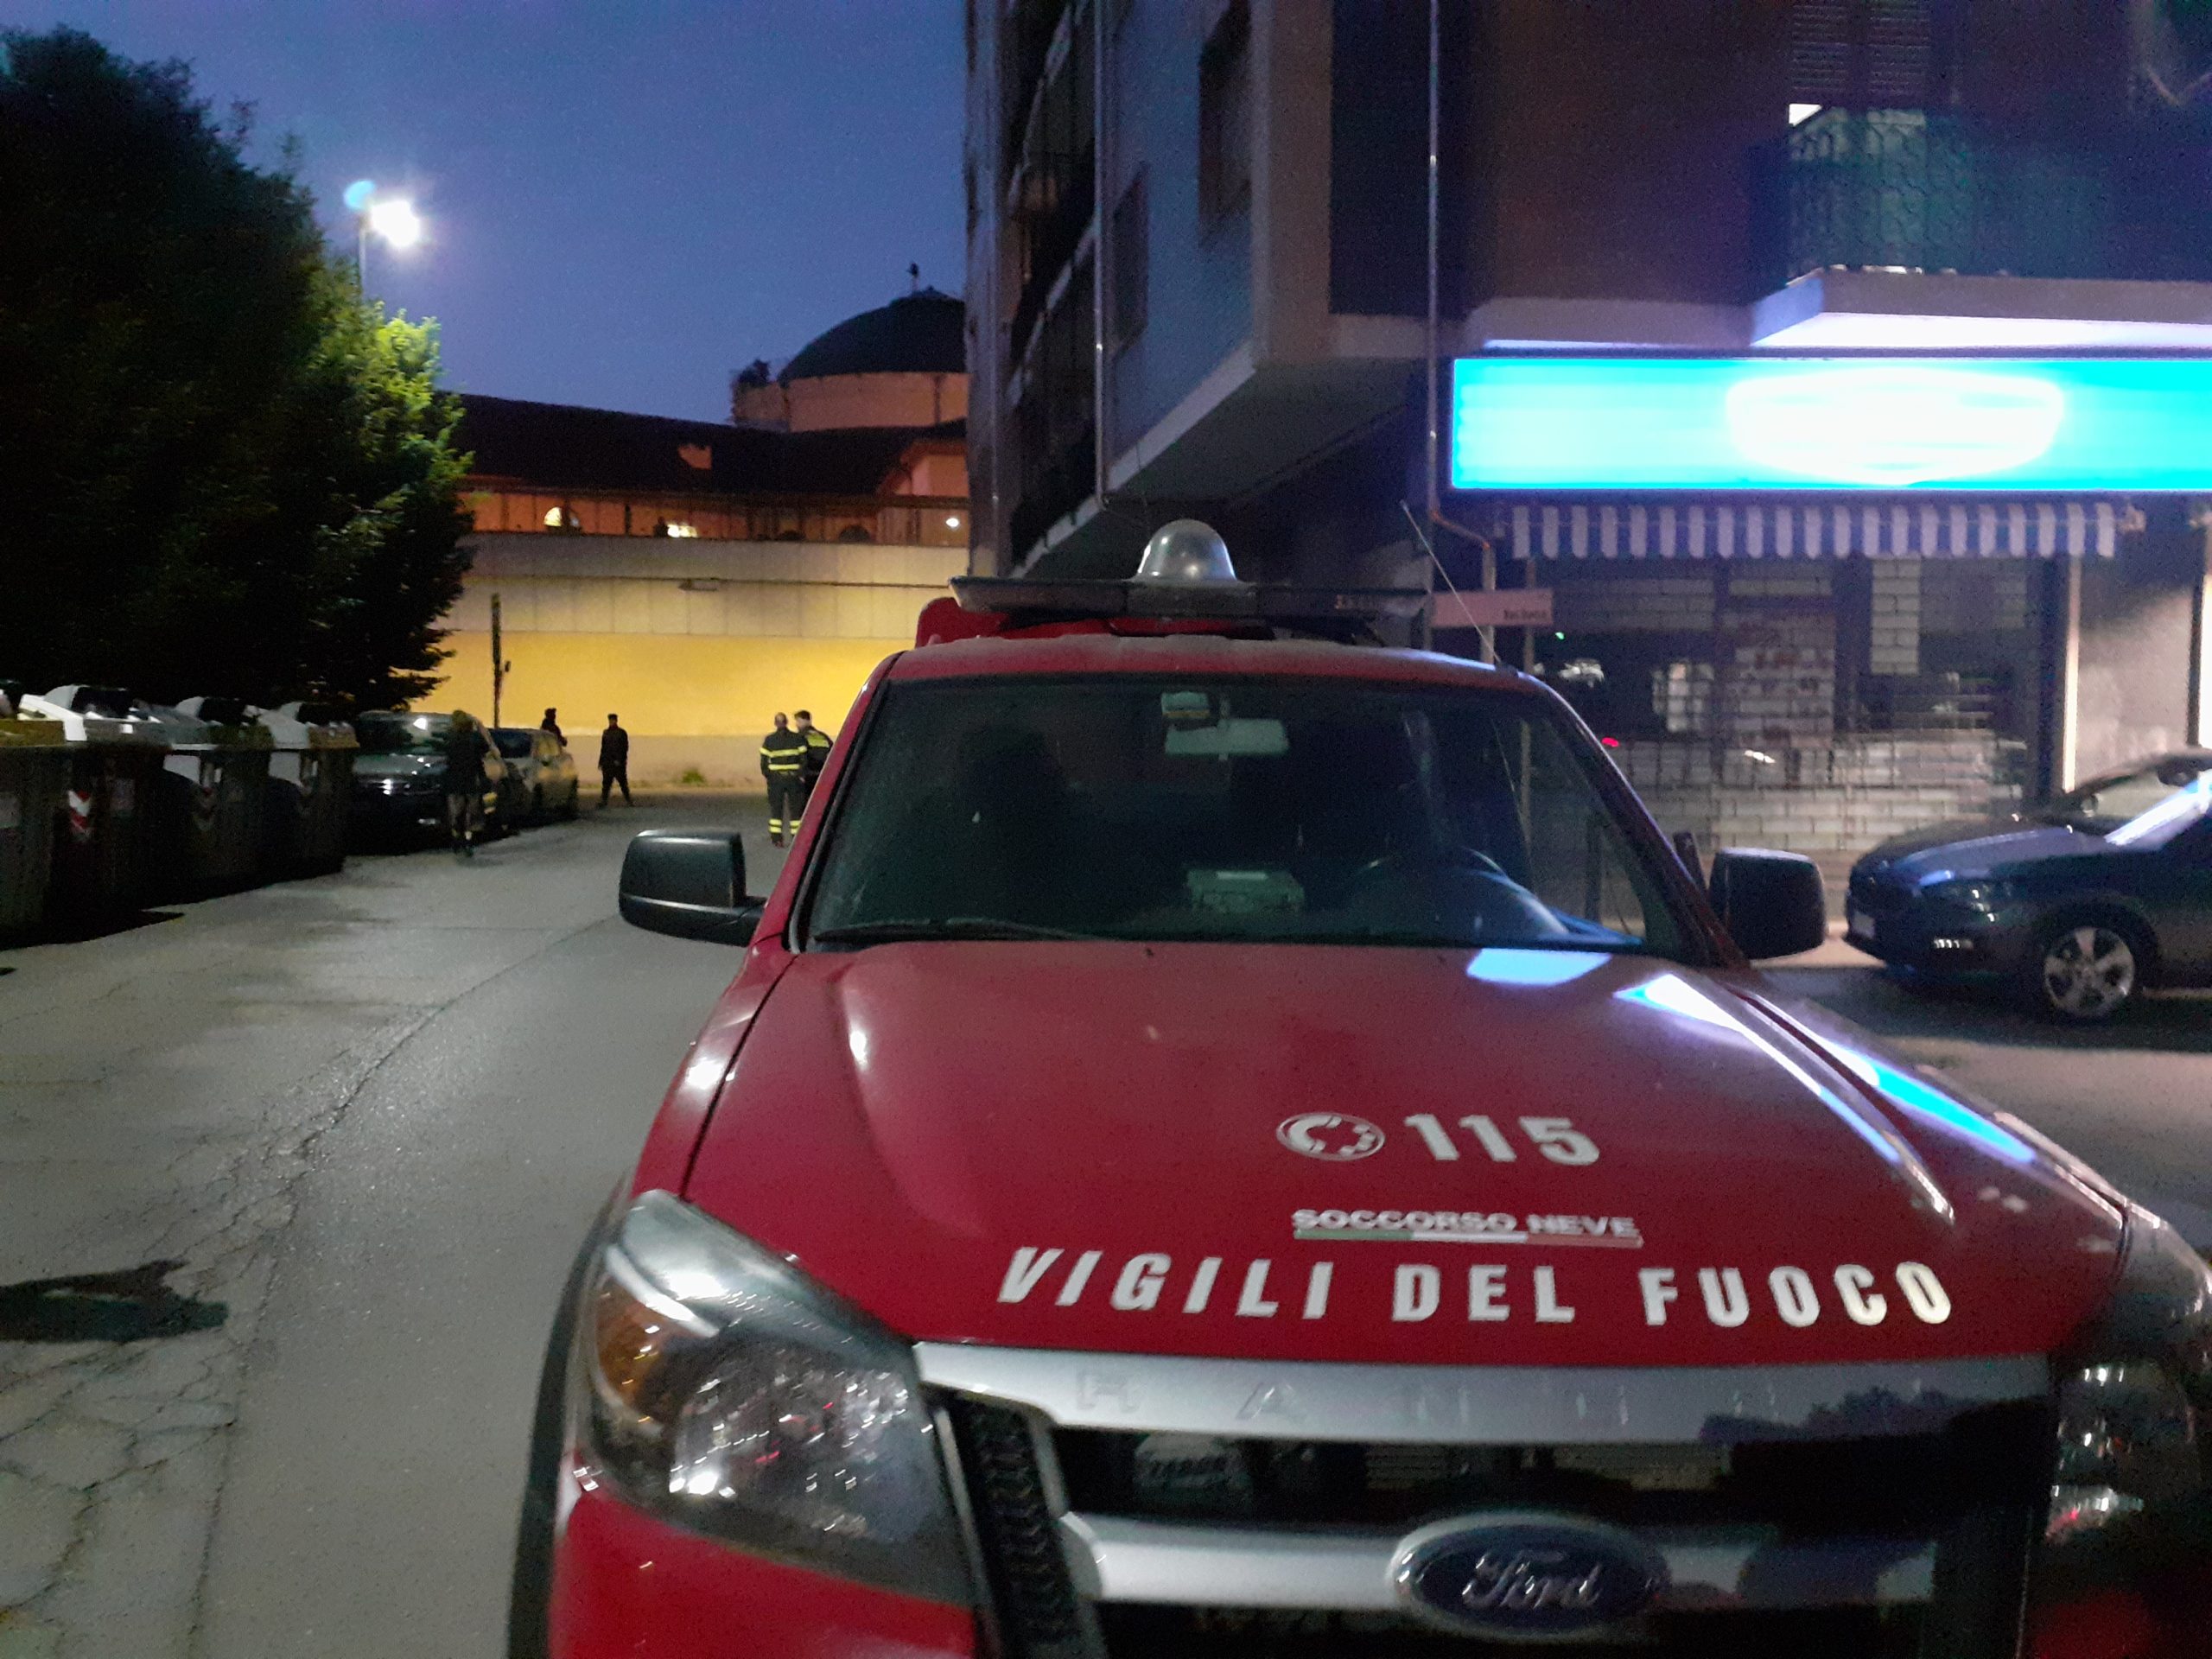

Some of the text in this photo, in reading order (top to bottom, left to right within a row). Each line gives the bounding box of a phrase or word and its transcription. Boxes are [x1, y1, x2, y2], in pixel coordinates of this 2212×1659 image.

[1403, 1114, 1600, 1166] 115
[1292, 1209, 1641, 1236] SOCCORSO NEVE
[996, 1247, 1952, 1327] VIGILI DEL FUOCO
[1461, 1551, 1600, 1608] Ford
